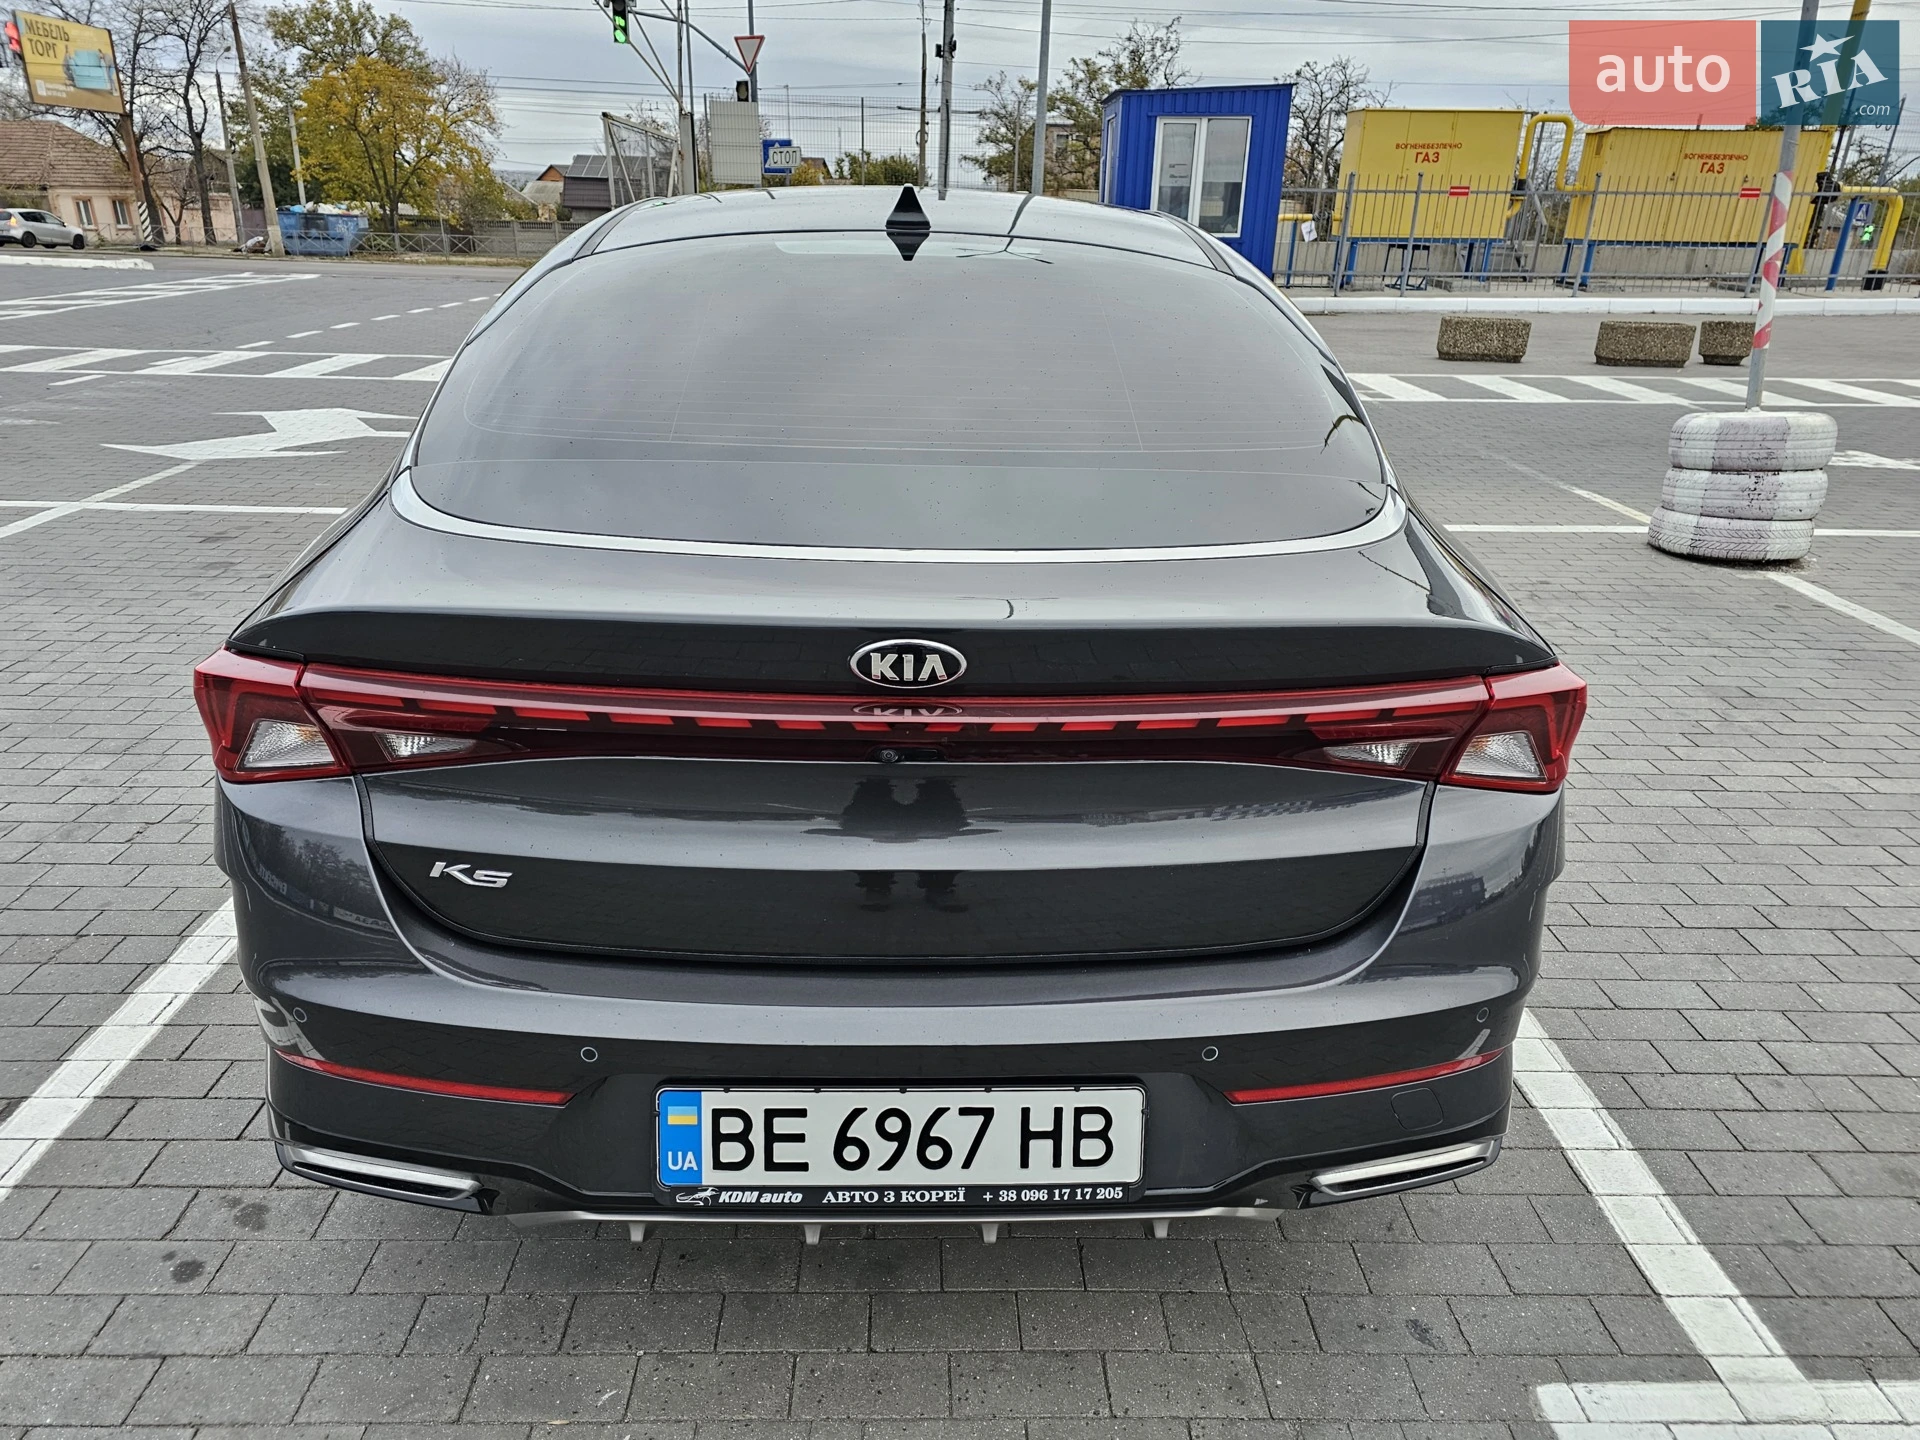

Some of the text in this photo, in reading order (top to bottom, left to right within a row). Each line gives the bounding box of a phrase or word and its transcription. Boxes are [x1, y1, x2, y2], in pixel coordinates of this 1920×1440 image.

[24, 18, 70, 42] МЕБЕЛЬ
[27, 38, 58, 59] ТОРГ
[1395, 142, 1463, 150] ВОГНЕНЕБЕЗПЕЧНО
[772, 150, 797, 165] СТОП
[1415, 151, 1440, 163] ГАЗ
[1700, 162, 1725, 174] ГАЗ
[870, 653, 948, 681] KIA
[711, 1106, 1114, 1172] BE 6967 HB
[667, 1151, 698, 1171] UA
[718, 1191, 803, 1203] KDM auto
[822, 1190, 879, 1203] АВТО
[900, 1187, 966, 1203] КОРЕЇ
[1021, 1189, 1049, 1202] 096
[1053, 1188, 1071, 1201] 17
[1075, 1187, 1093, 1200] 17
[1096, 1186, 1123, 1200] 205
